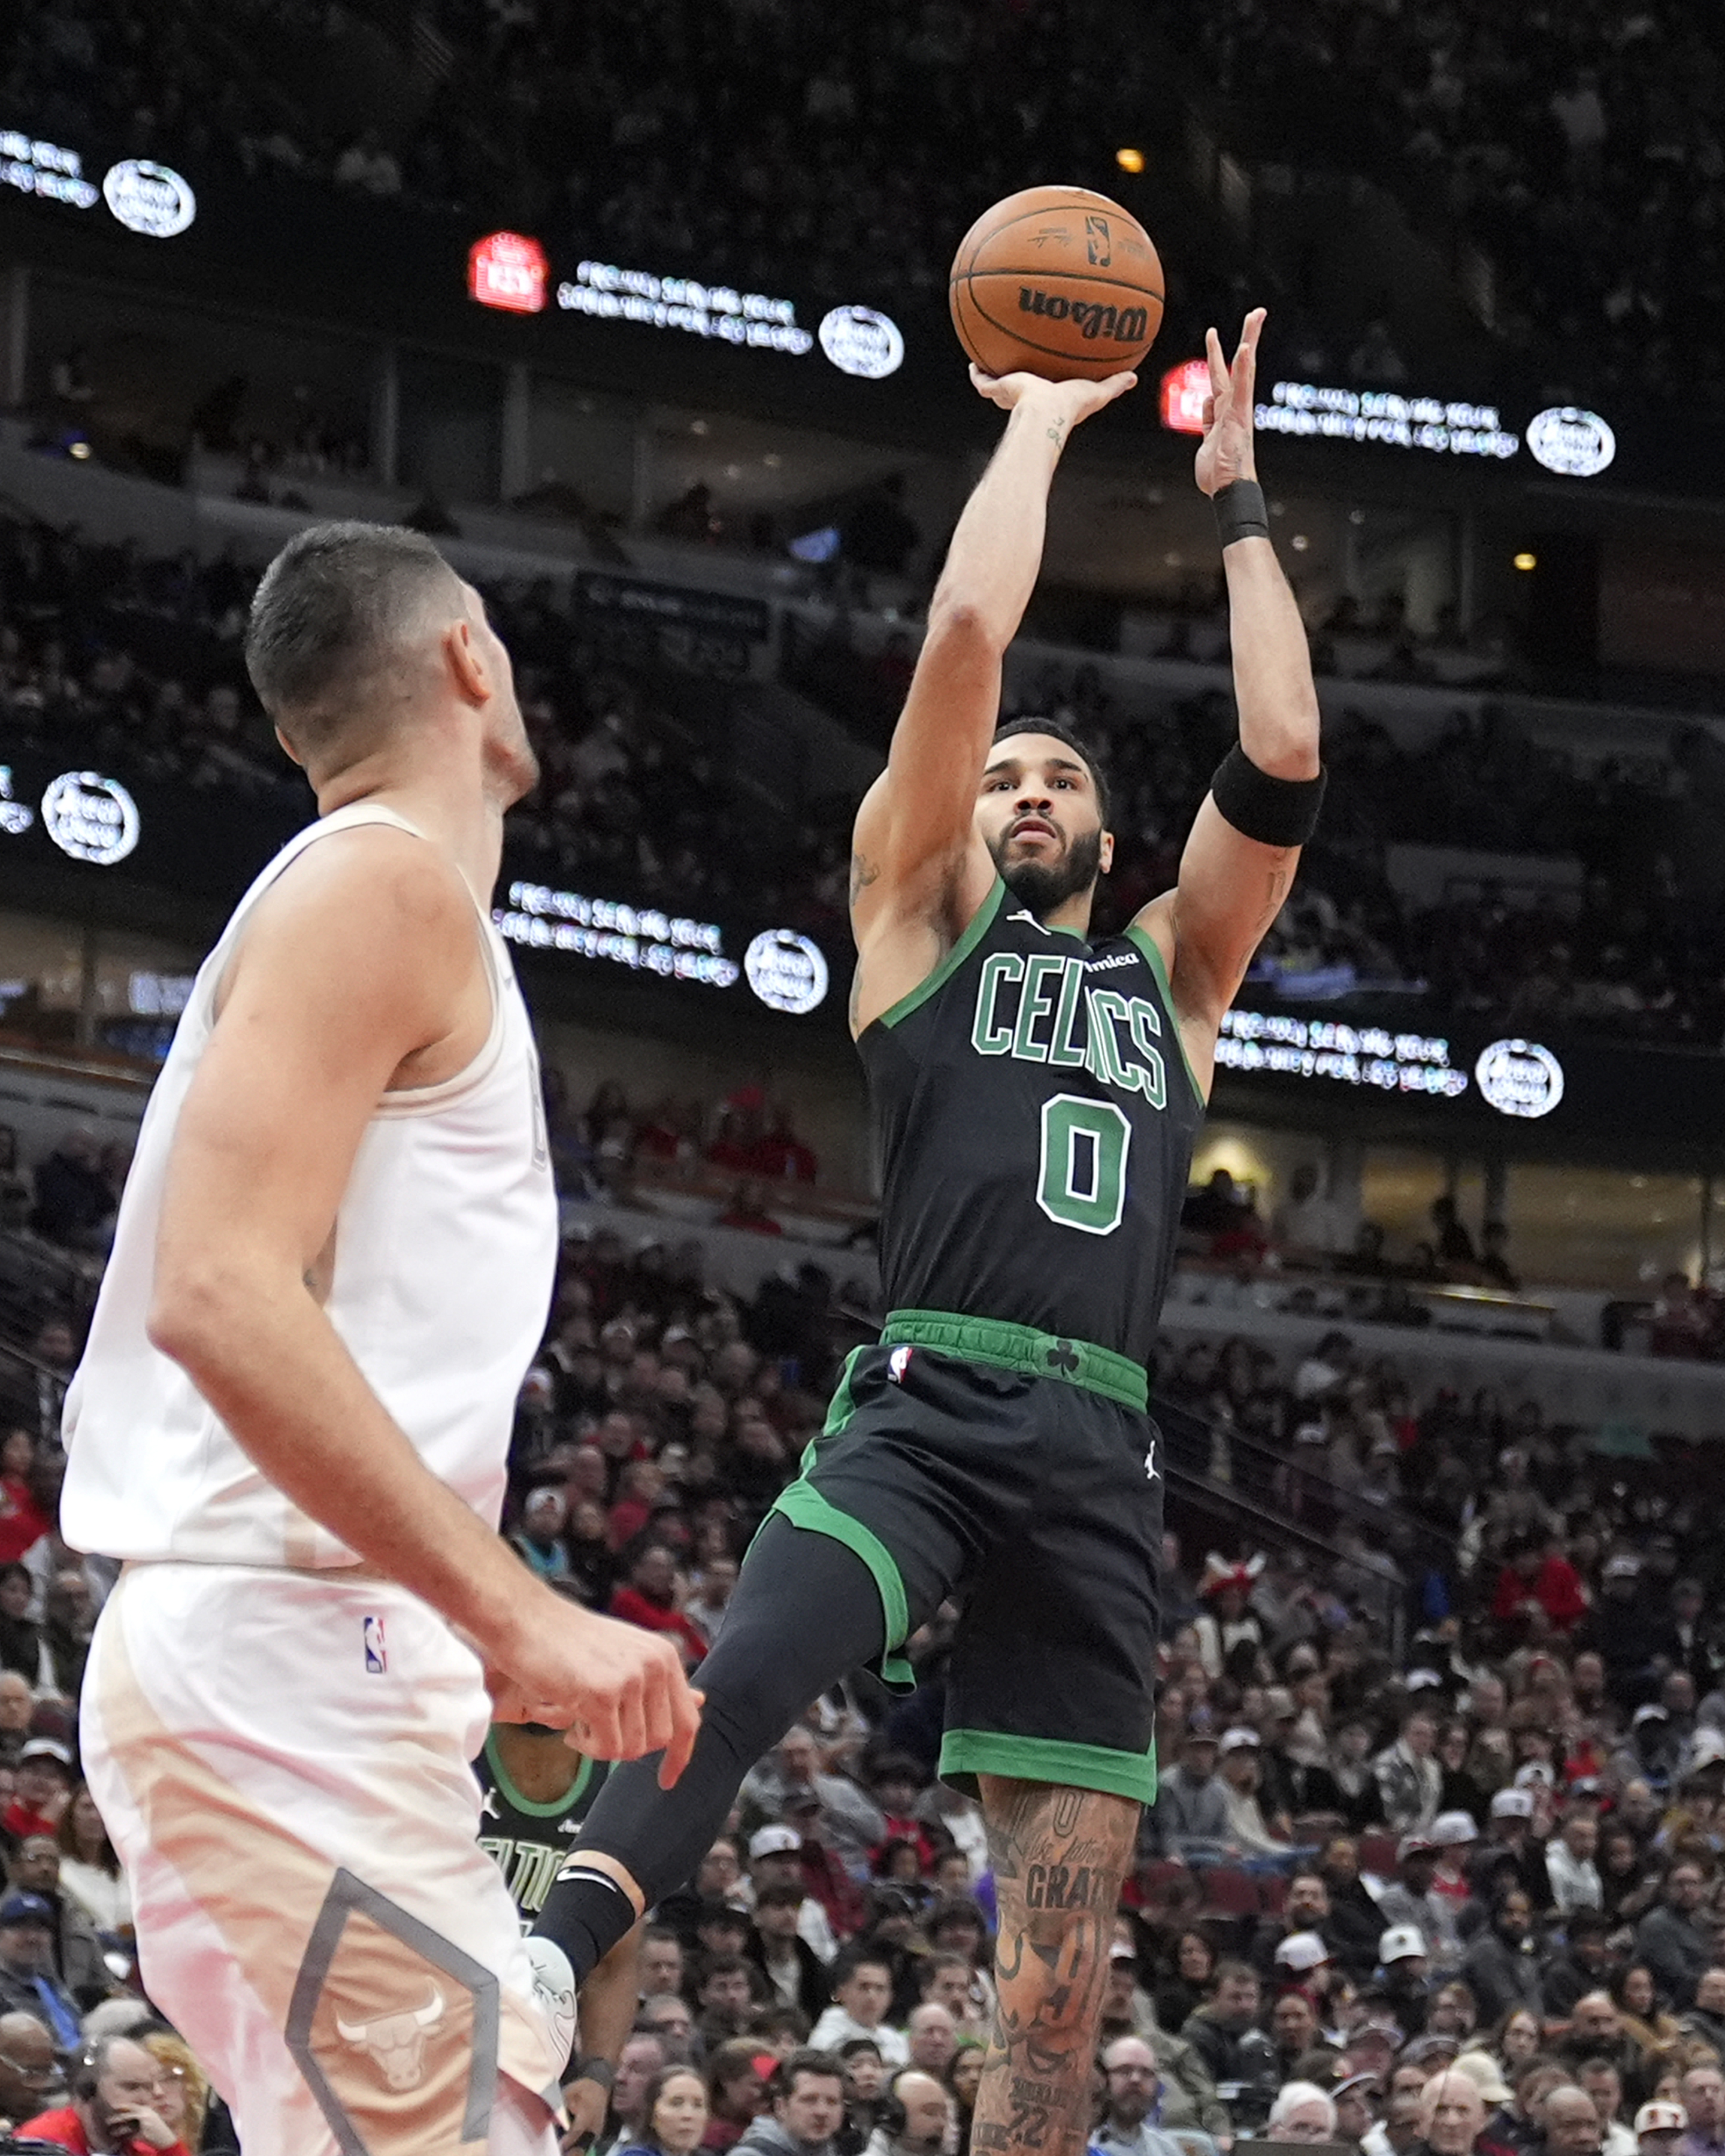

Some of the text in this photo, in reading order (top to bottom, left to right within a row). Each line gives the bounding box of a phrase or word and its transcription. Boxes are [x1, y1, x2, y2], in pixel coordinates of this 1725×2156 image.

[1019, 286, 1148, 342] Wilson
[970, 952, 1167, 1110] CELICS
[1036, 1093, 1131, 1236] 0
